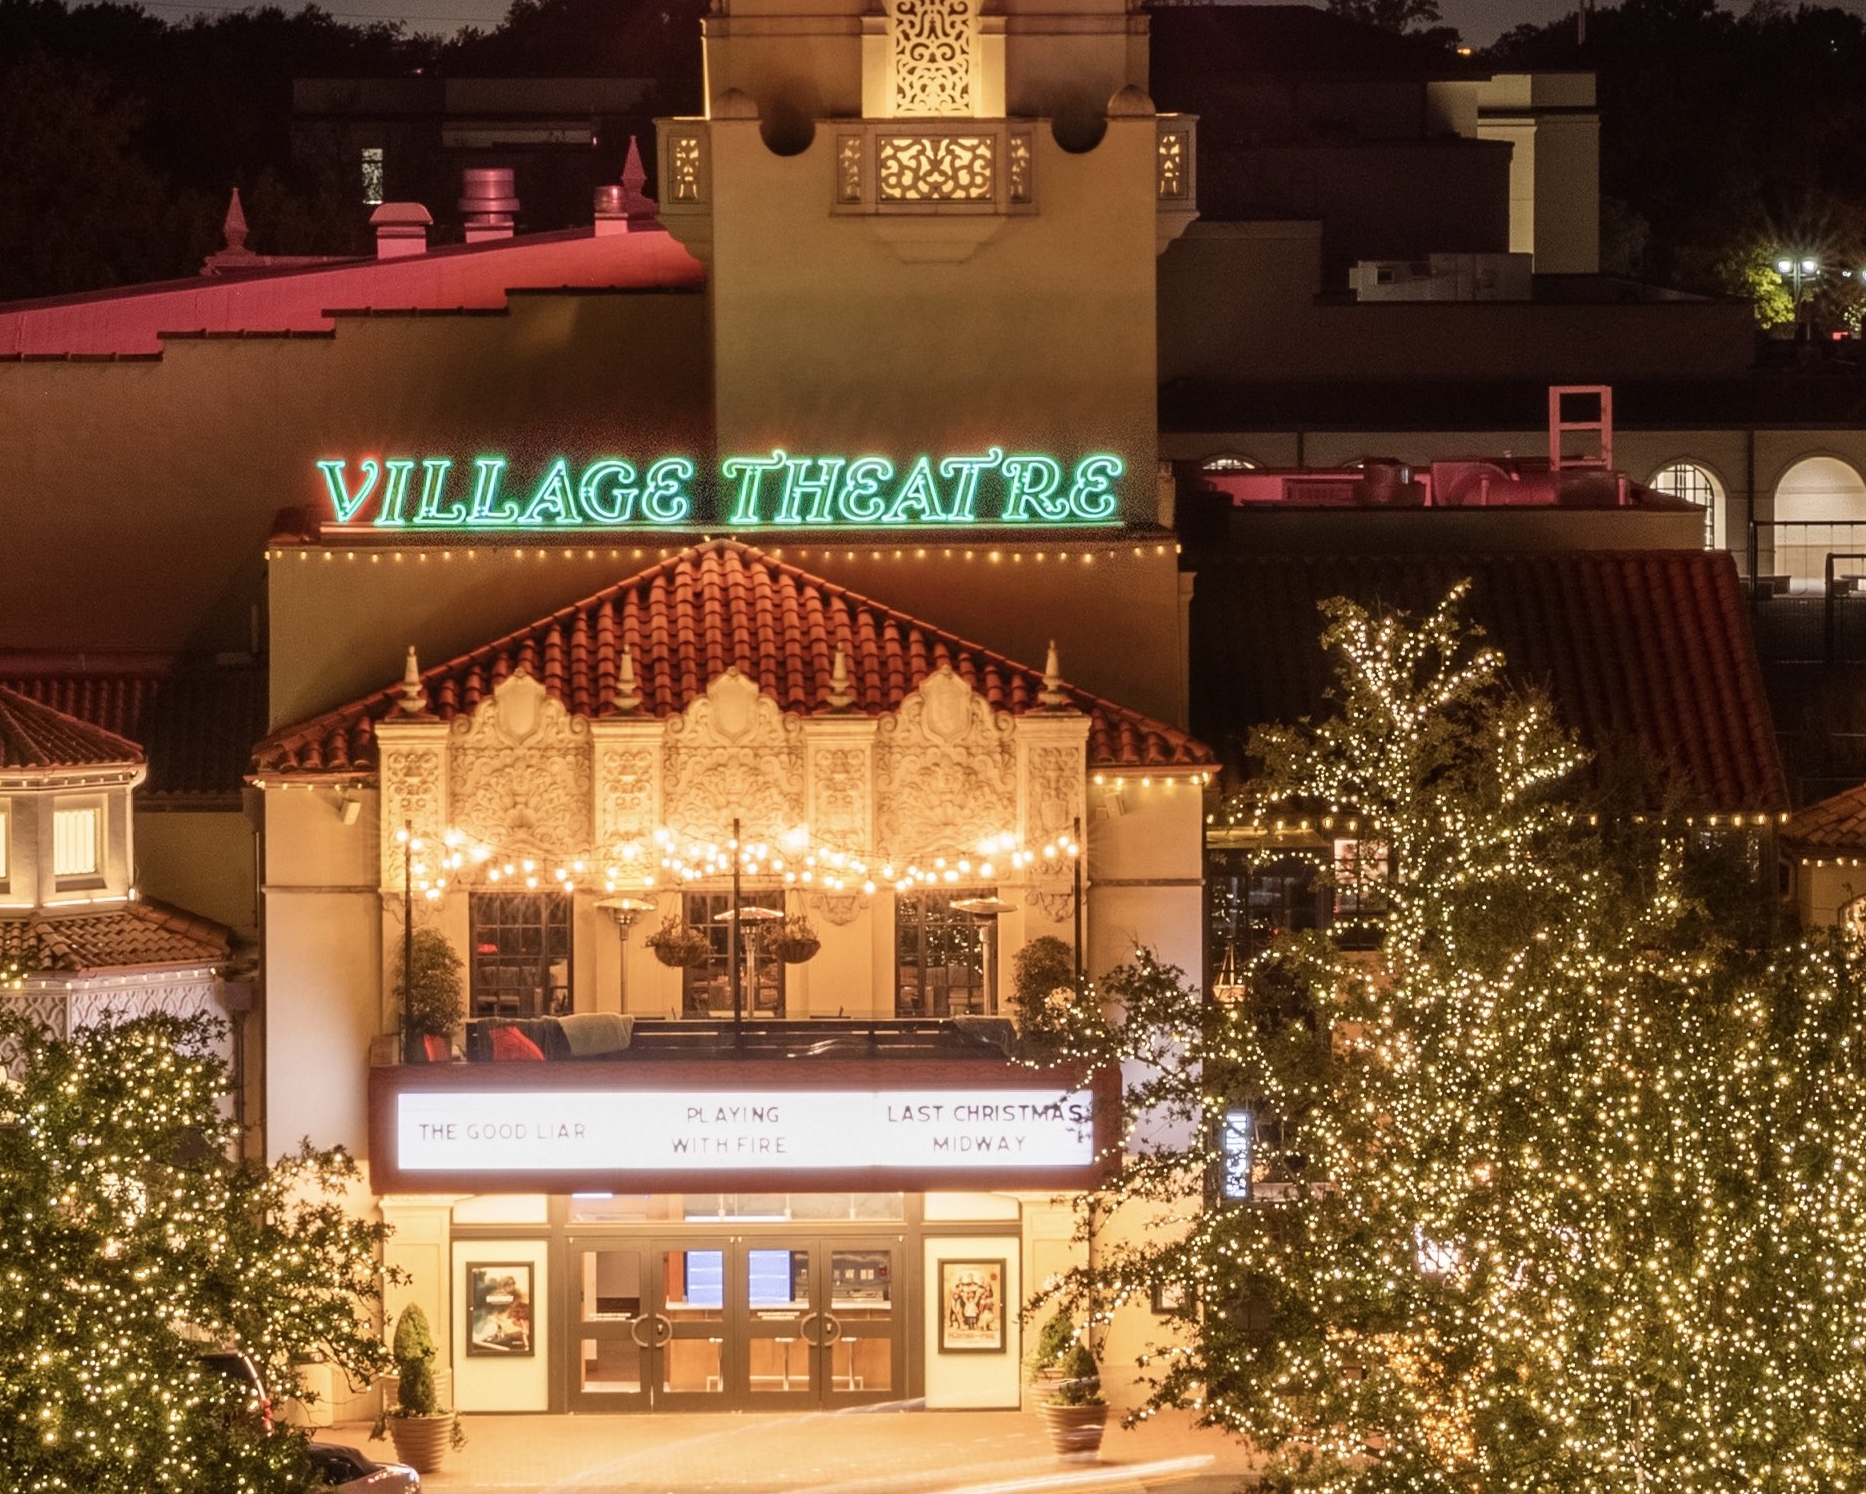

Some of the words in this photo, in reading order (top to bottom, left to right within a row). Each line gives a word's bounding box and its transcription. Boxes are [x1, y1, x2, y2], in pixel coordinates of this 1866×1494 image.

[315, 454, 694, 528] VILLAGE
[721, 446, 1125, 526] THEATRE
[686, 1106, 780, 1124] PLAYING
[887, 1104, 945, 1123] LAST
[953, 1103, 1084, 1123] CHRISTMAS
[419, 1123, 458, 1140] THE
[466, 1123, 528, 1140] GOOD
[537, 1122, 587, 1140] LIAR
[671, 1136, 729, 1154] WITH
[736, 1136, 788, 1154] FIRE
[932, 1135, 1027, 1153] MIDWAY
